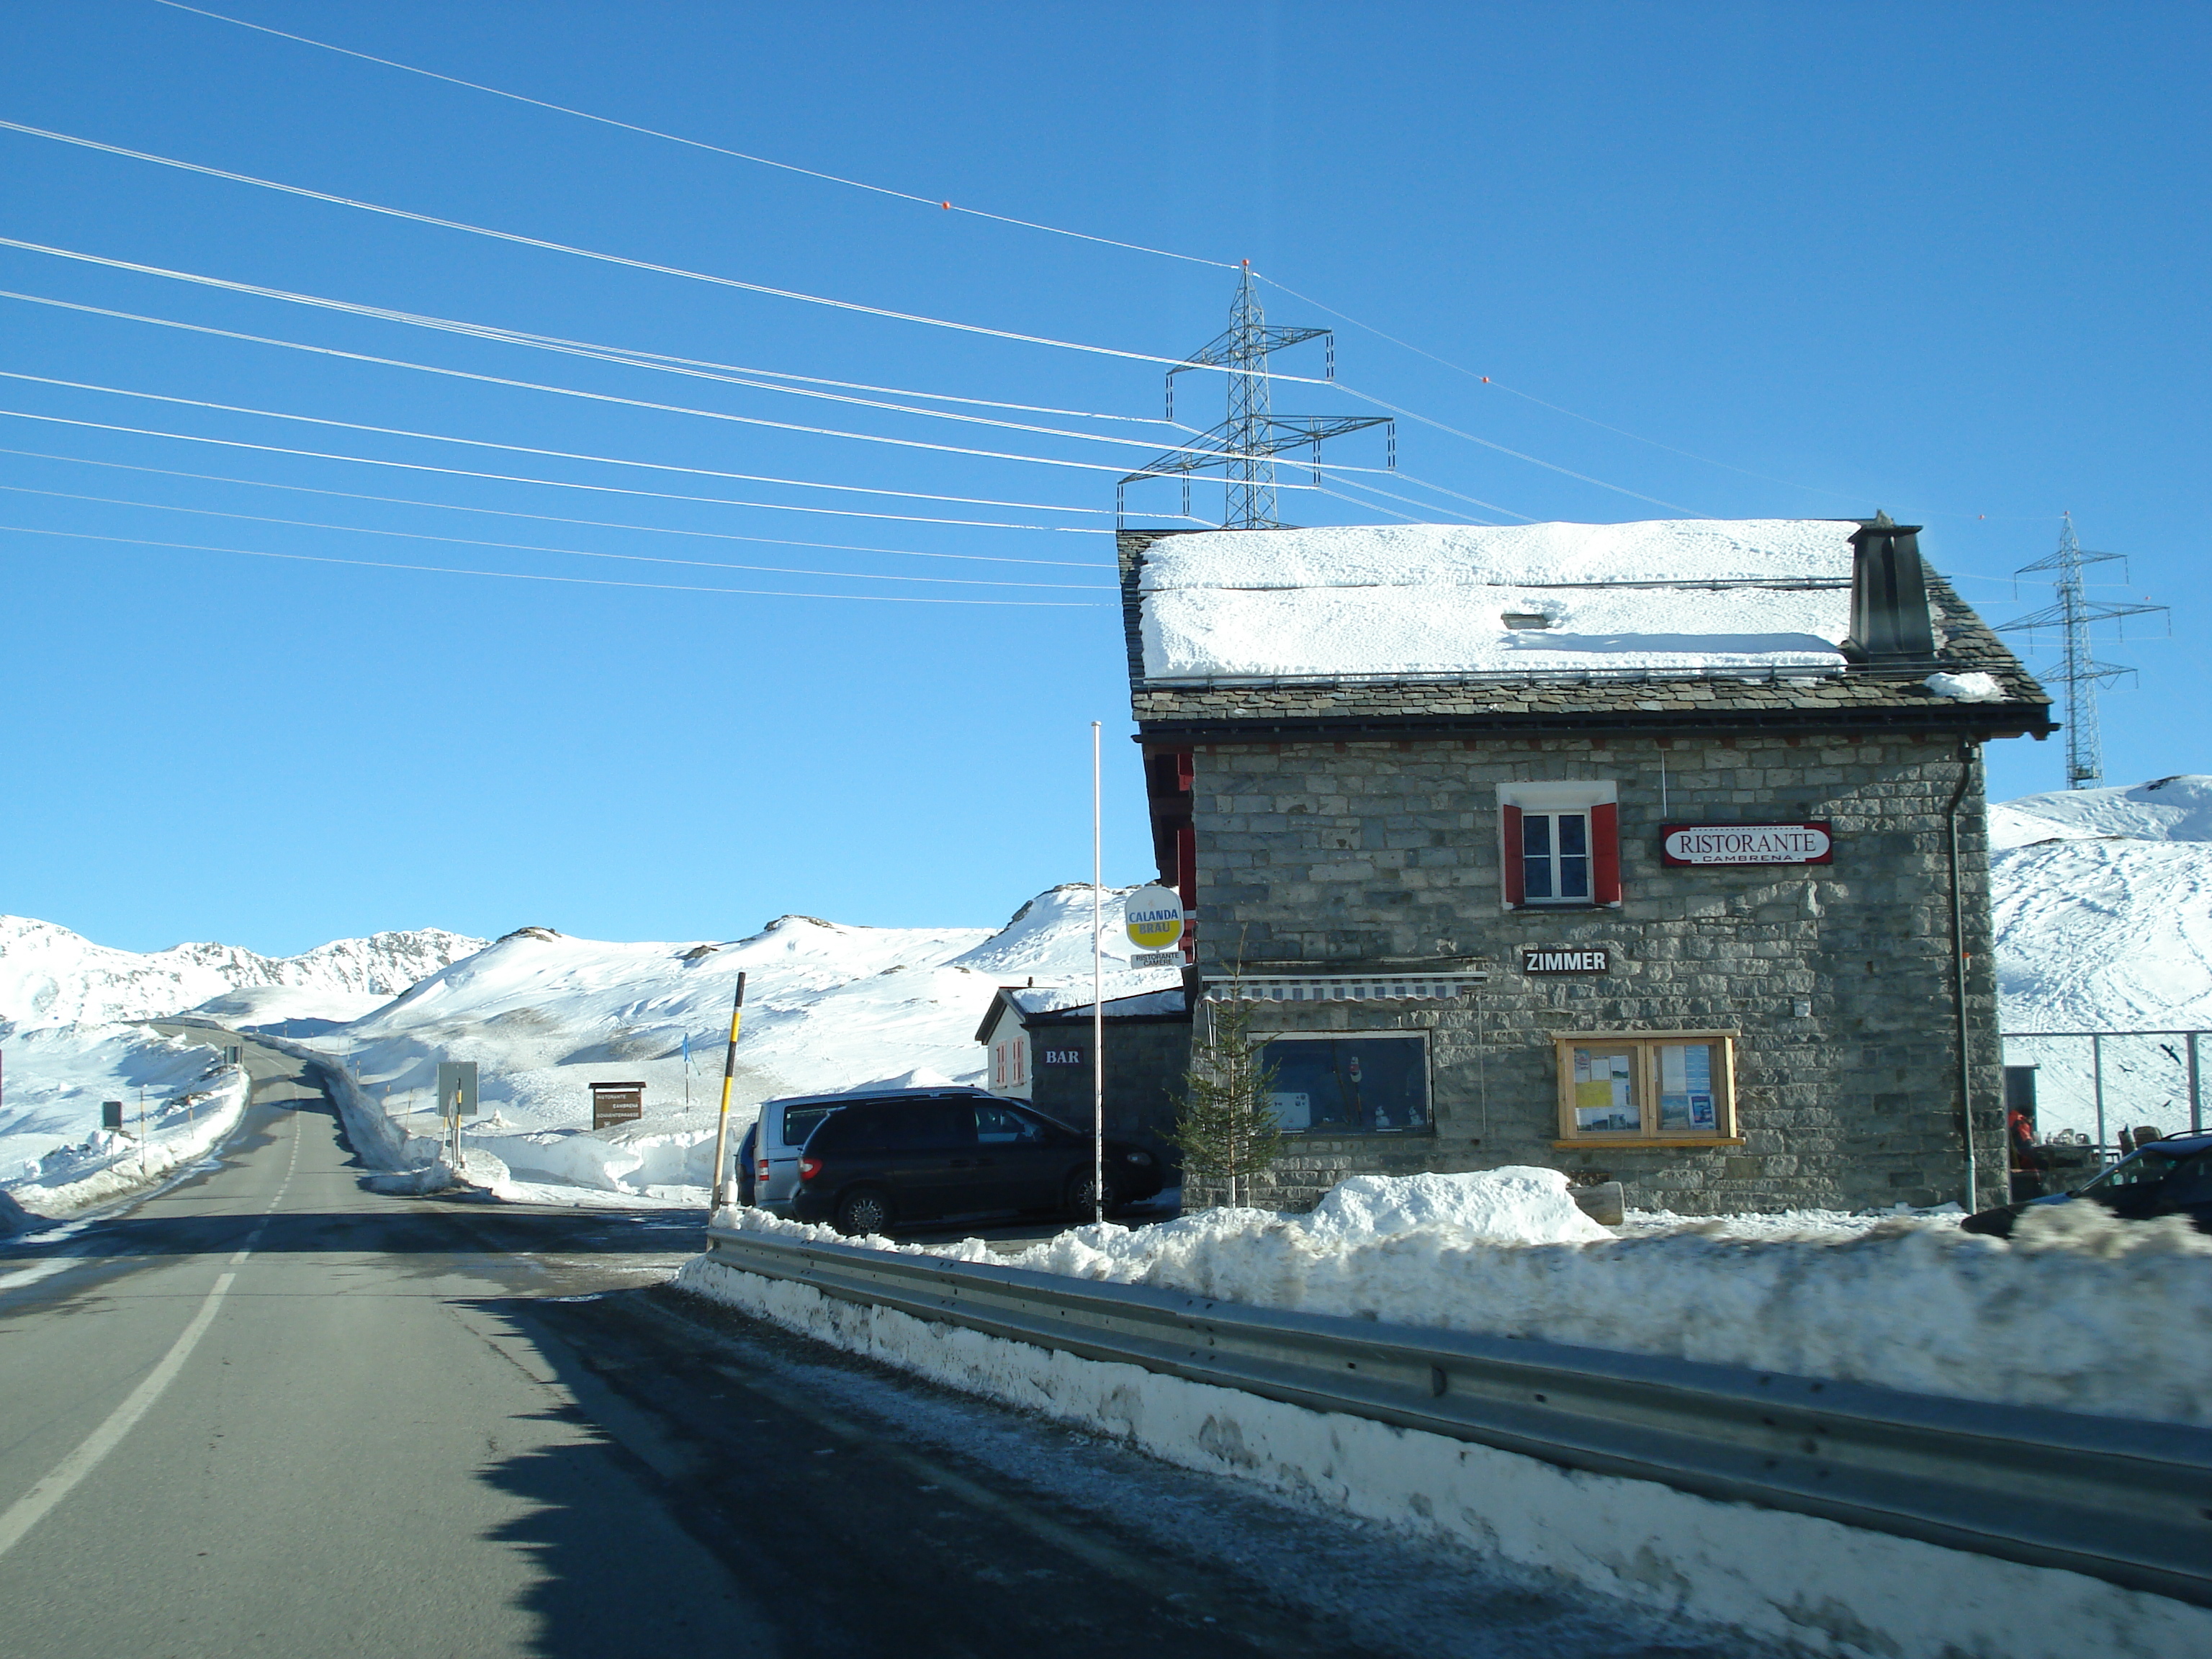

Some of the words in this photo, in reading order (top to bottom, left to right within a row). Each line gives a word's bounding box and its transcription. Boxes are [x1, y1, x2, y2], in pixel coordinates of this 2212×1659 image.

[1681, 834, 1816, 853] RISTORANTE
[1129, 909, 1178, 922] CALANDA
[1136, 953, 1179, 961] RISTORANTE
[1527, 952, 1606, 971] ZIMMER
[1046, 1051, 1079, 1064] BAR
